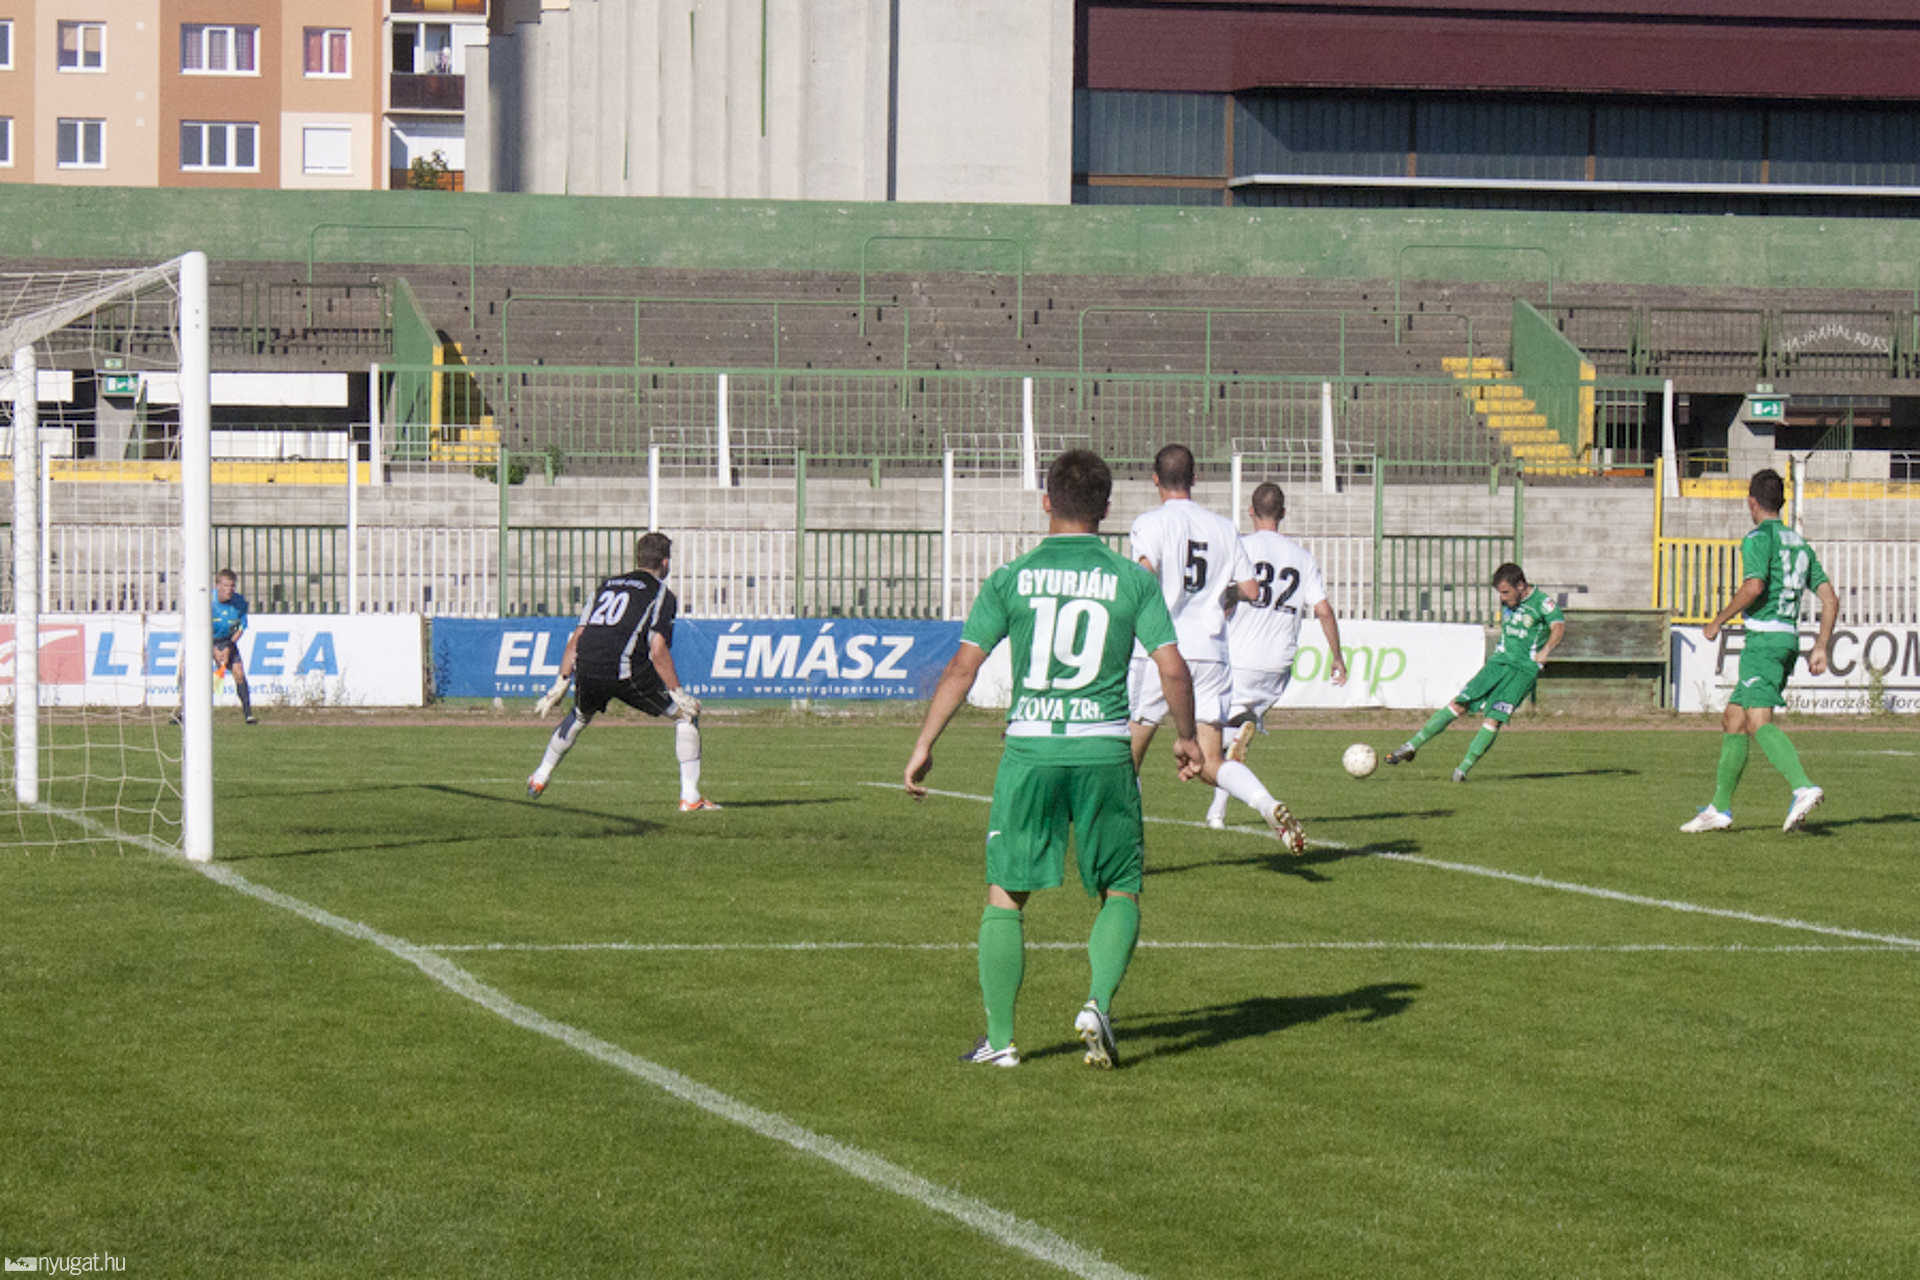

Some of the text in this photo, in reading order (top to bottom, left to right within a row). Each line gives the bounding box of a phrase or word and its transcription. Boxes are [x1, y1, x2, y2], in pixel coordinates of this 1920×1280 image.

[1017, 567, 1118, 602] GYURJÁN
[1183, 539, 1208, 593] 5
[1250, 560, 1300, 615] 32
[589, 590, 630, 626] 20
[92, 632, 338, 676] LEEA
[710, 622, 915, 679] ÉMÁSZ
[1023, 597, 1110, 690] 19
[1291, 645, 1407, 696] omp
